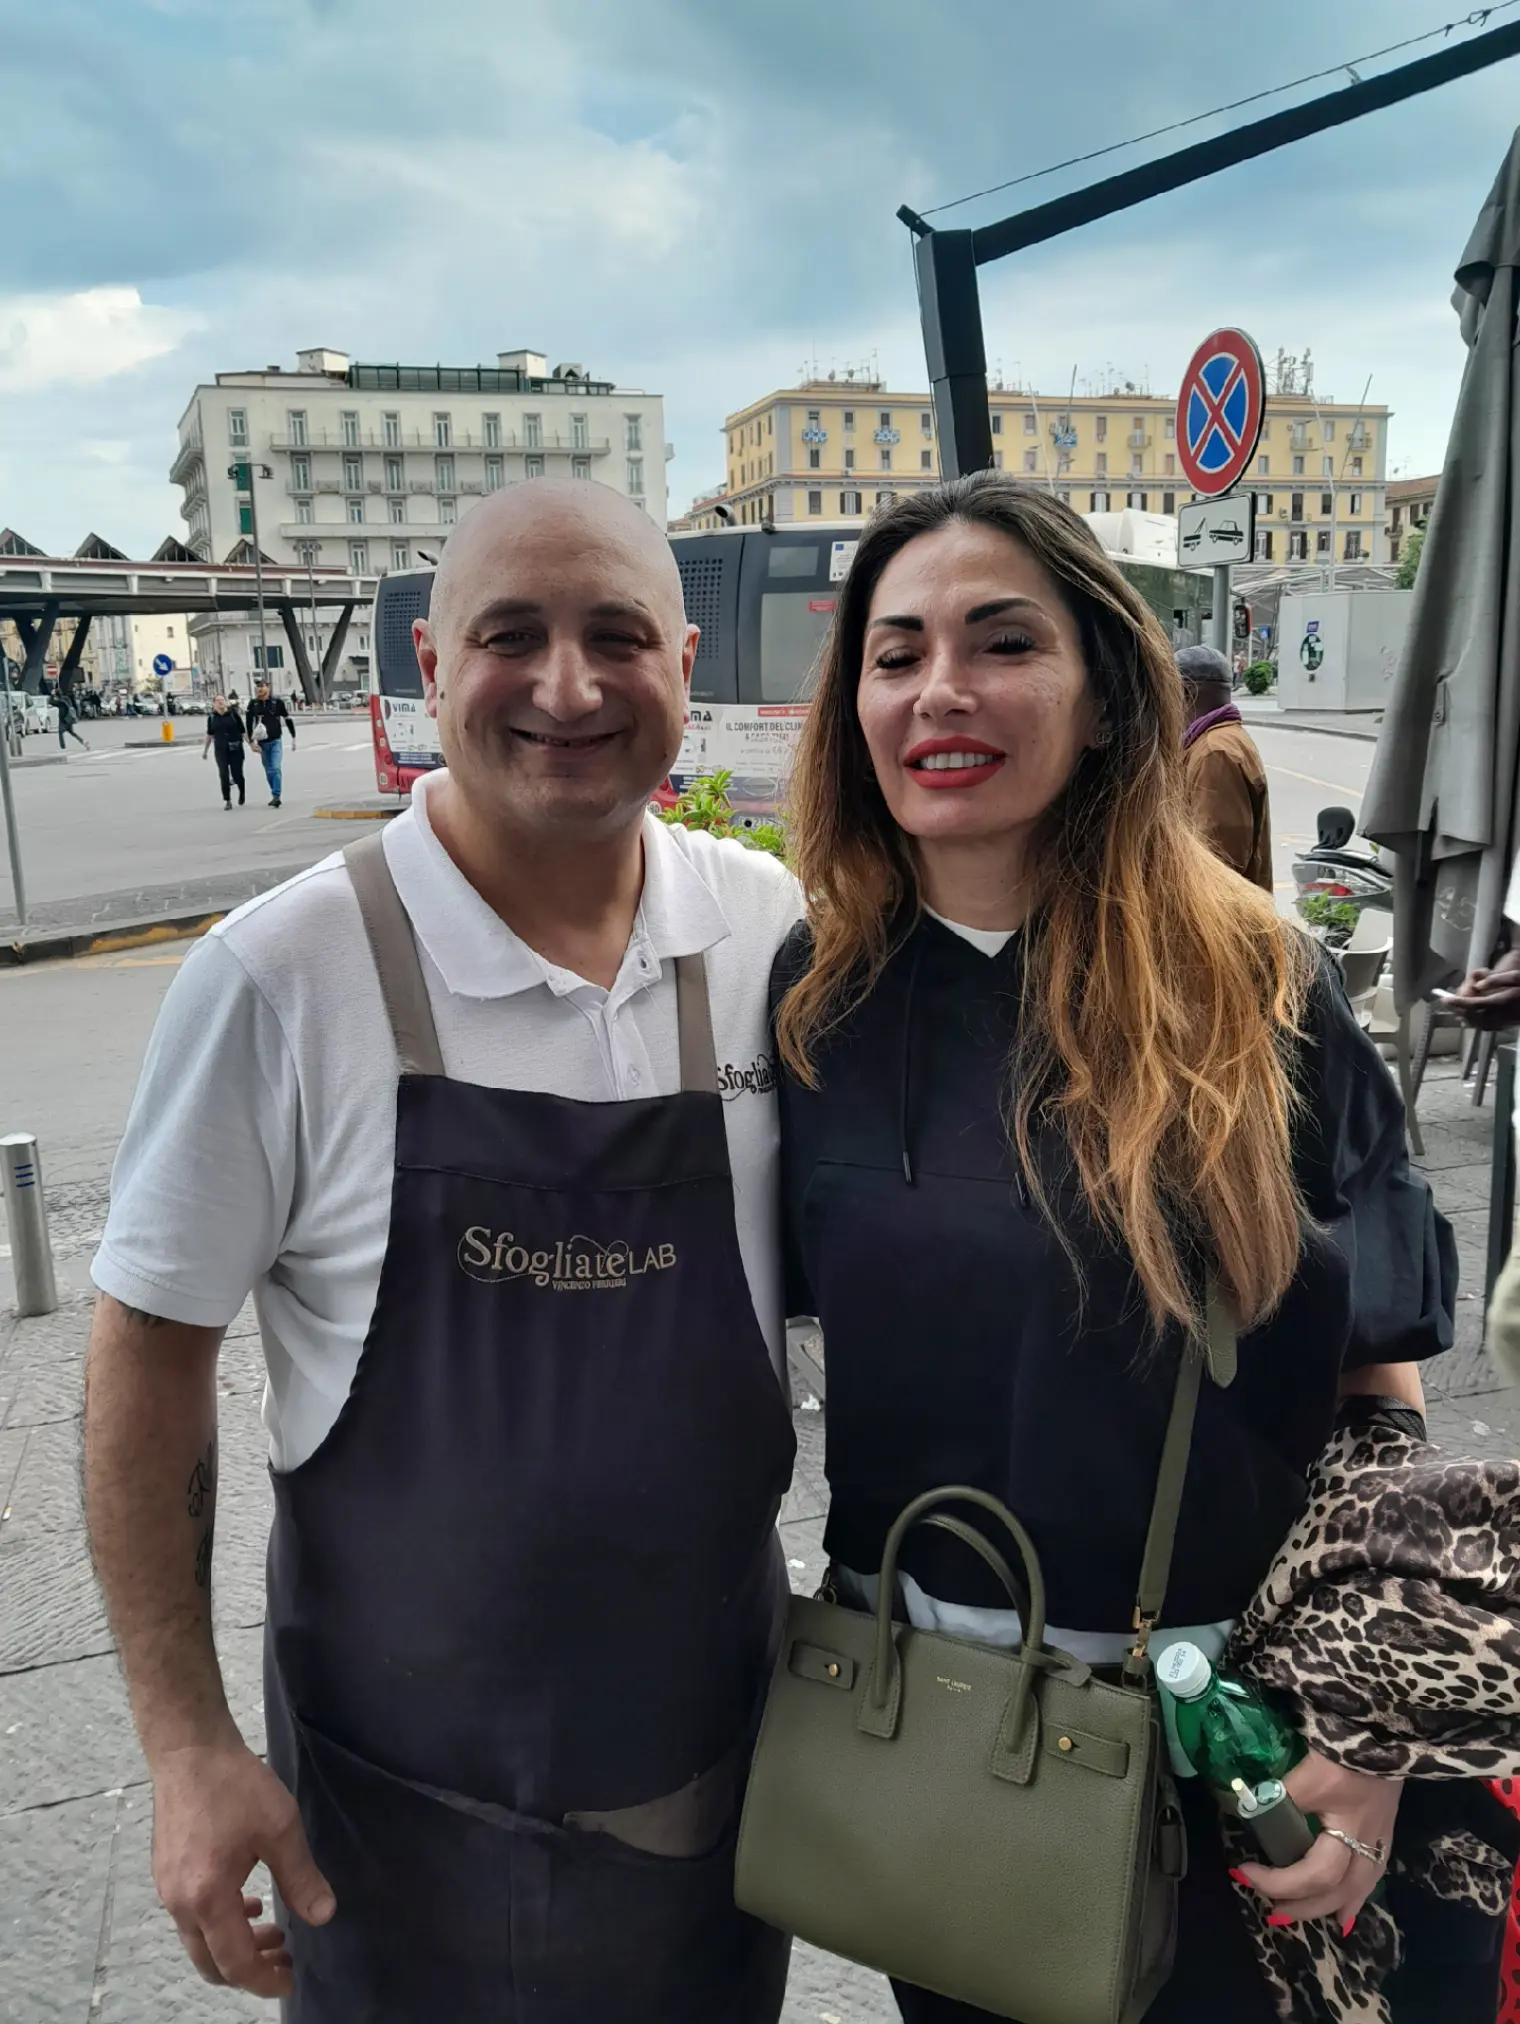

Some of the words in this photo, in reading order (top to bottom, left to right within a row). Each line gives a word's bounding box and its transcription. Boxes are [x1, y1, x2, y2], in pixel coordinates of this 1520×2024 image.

[393, 703, 416, 713] VIMA
[690, 711, 712, 721] MA
[734, 722, 768, 731] COMFORT
[769, 722, 783, 731] DEL
[717, 1061, 774, 1095] Sfoglia
